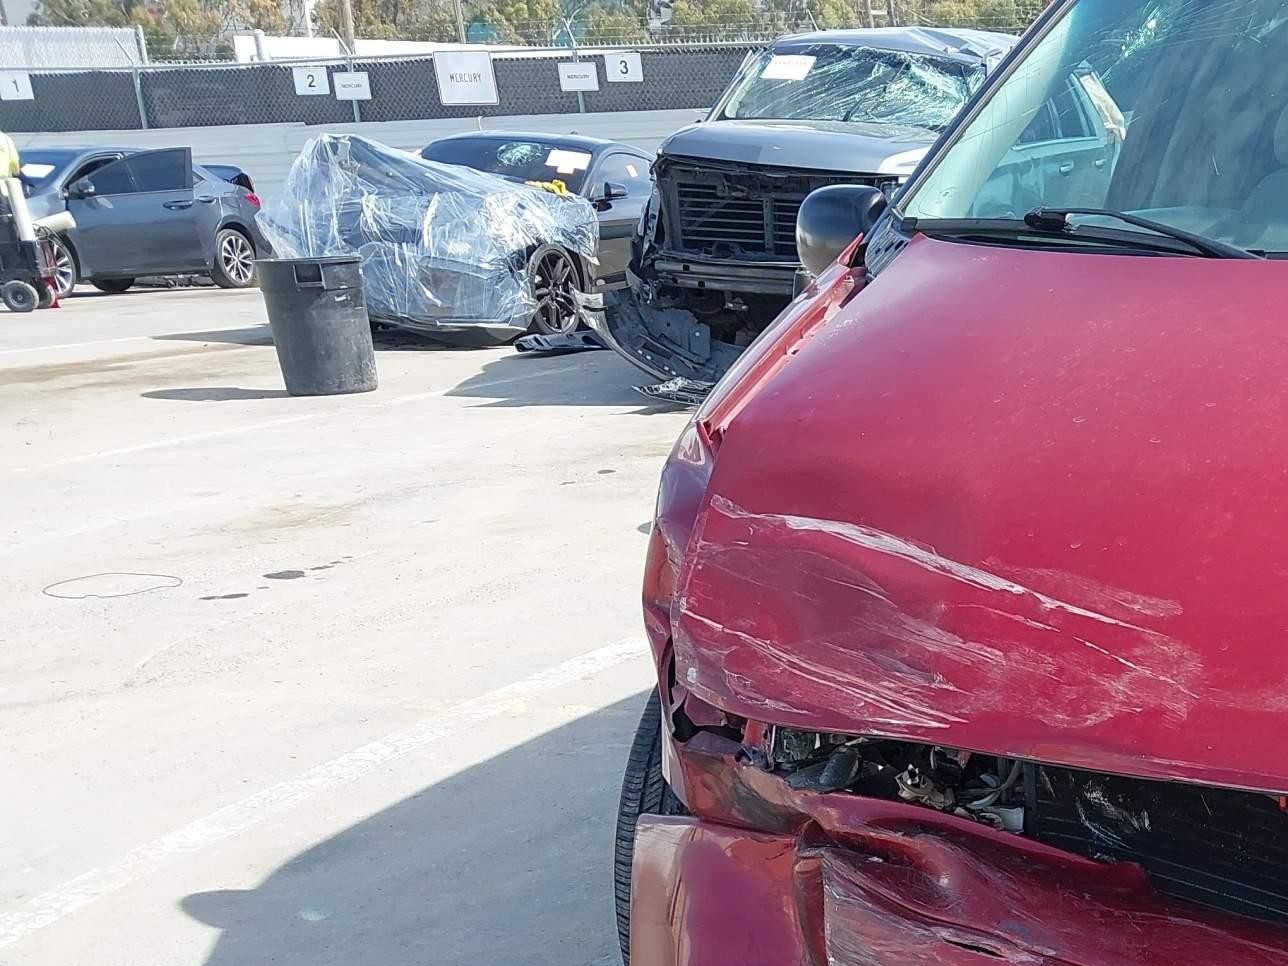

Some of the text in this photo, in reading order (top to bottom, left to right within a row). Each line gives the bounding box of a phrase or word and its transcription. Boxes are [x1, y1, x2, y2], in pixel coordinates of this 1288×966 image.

[619, 60, 630, 75] 3
[306, 74, 317, 88] 2
[449, 71, 482, 83] MERCURY
[11, 79, 20, 93] 1
